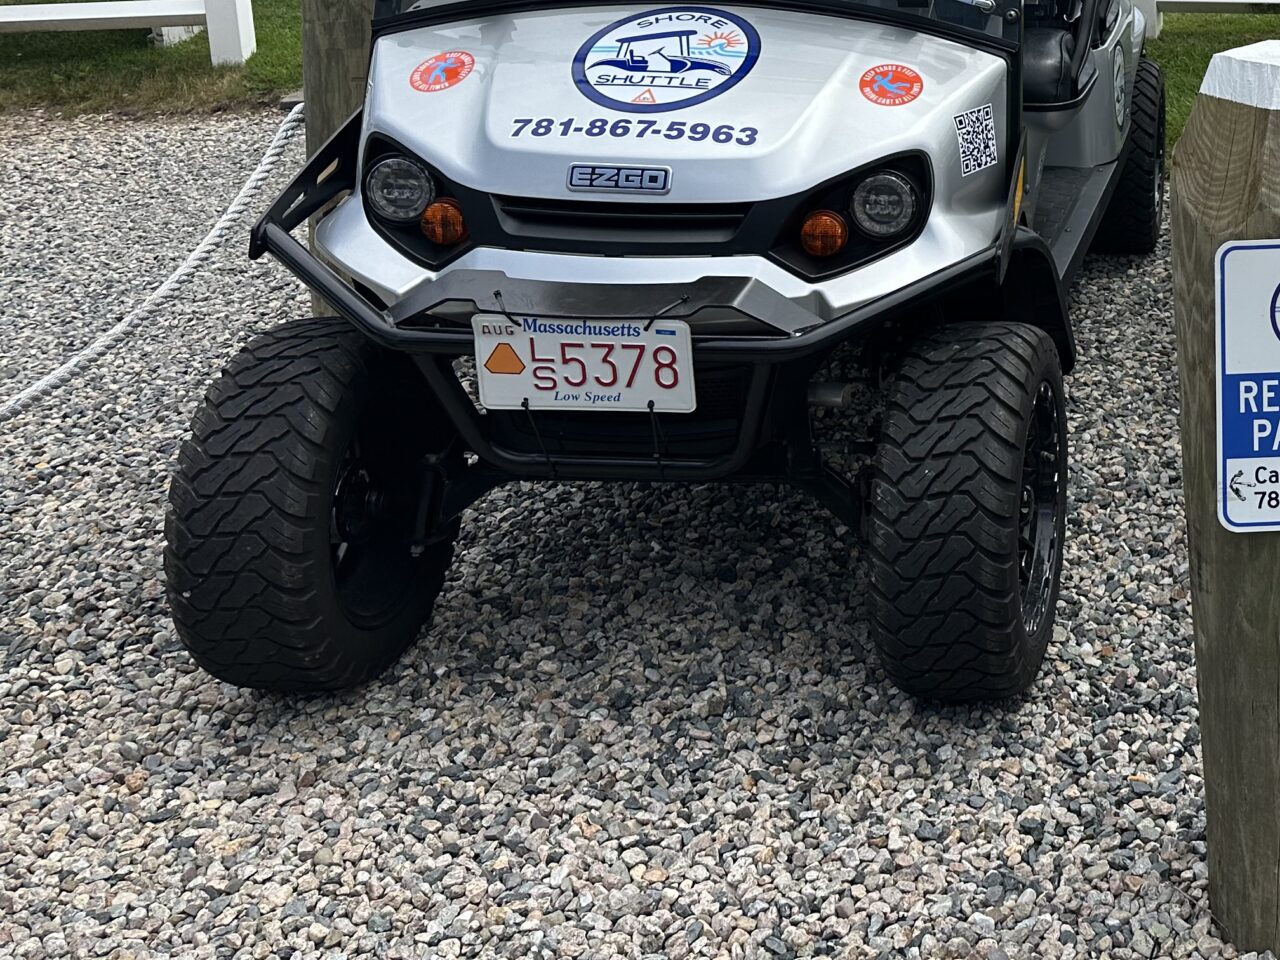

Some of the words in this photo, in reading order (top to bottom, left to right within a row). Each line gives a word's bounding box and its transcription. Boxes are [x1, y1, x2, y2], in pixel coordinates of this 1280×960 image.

[637, 13, 729, 29] SHORE
[596, 74, 712, 88] SHUTTLE
[512, 118, 757, 147] 781-867-5963
[570, 168, 668, 189] EZGO
[481, 324, 515, 336] AUG
[523, 319, 641, 337] Massachusetts
[554, 391, 581, 403] Low
[584, 392, 621, 404] Speed
